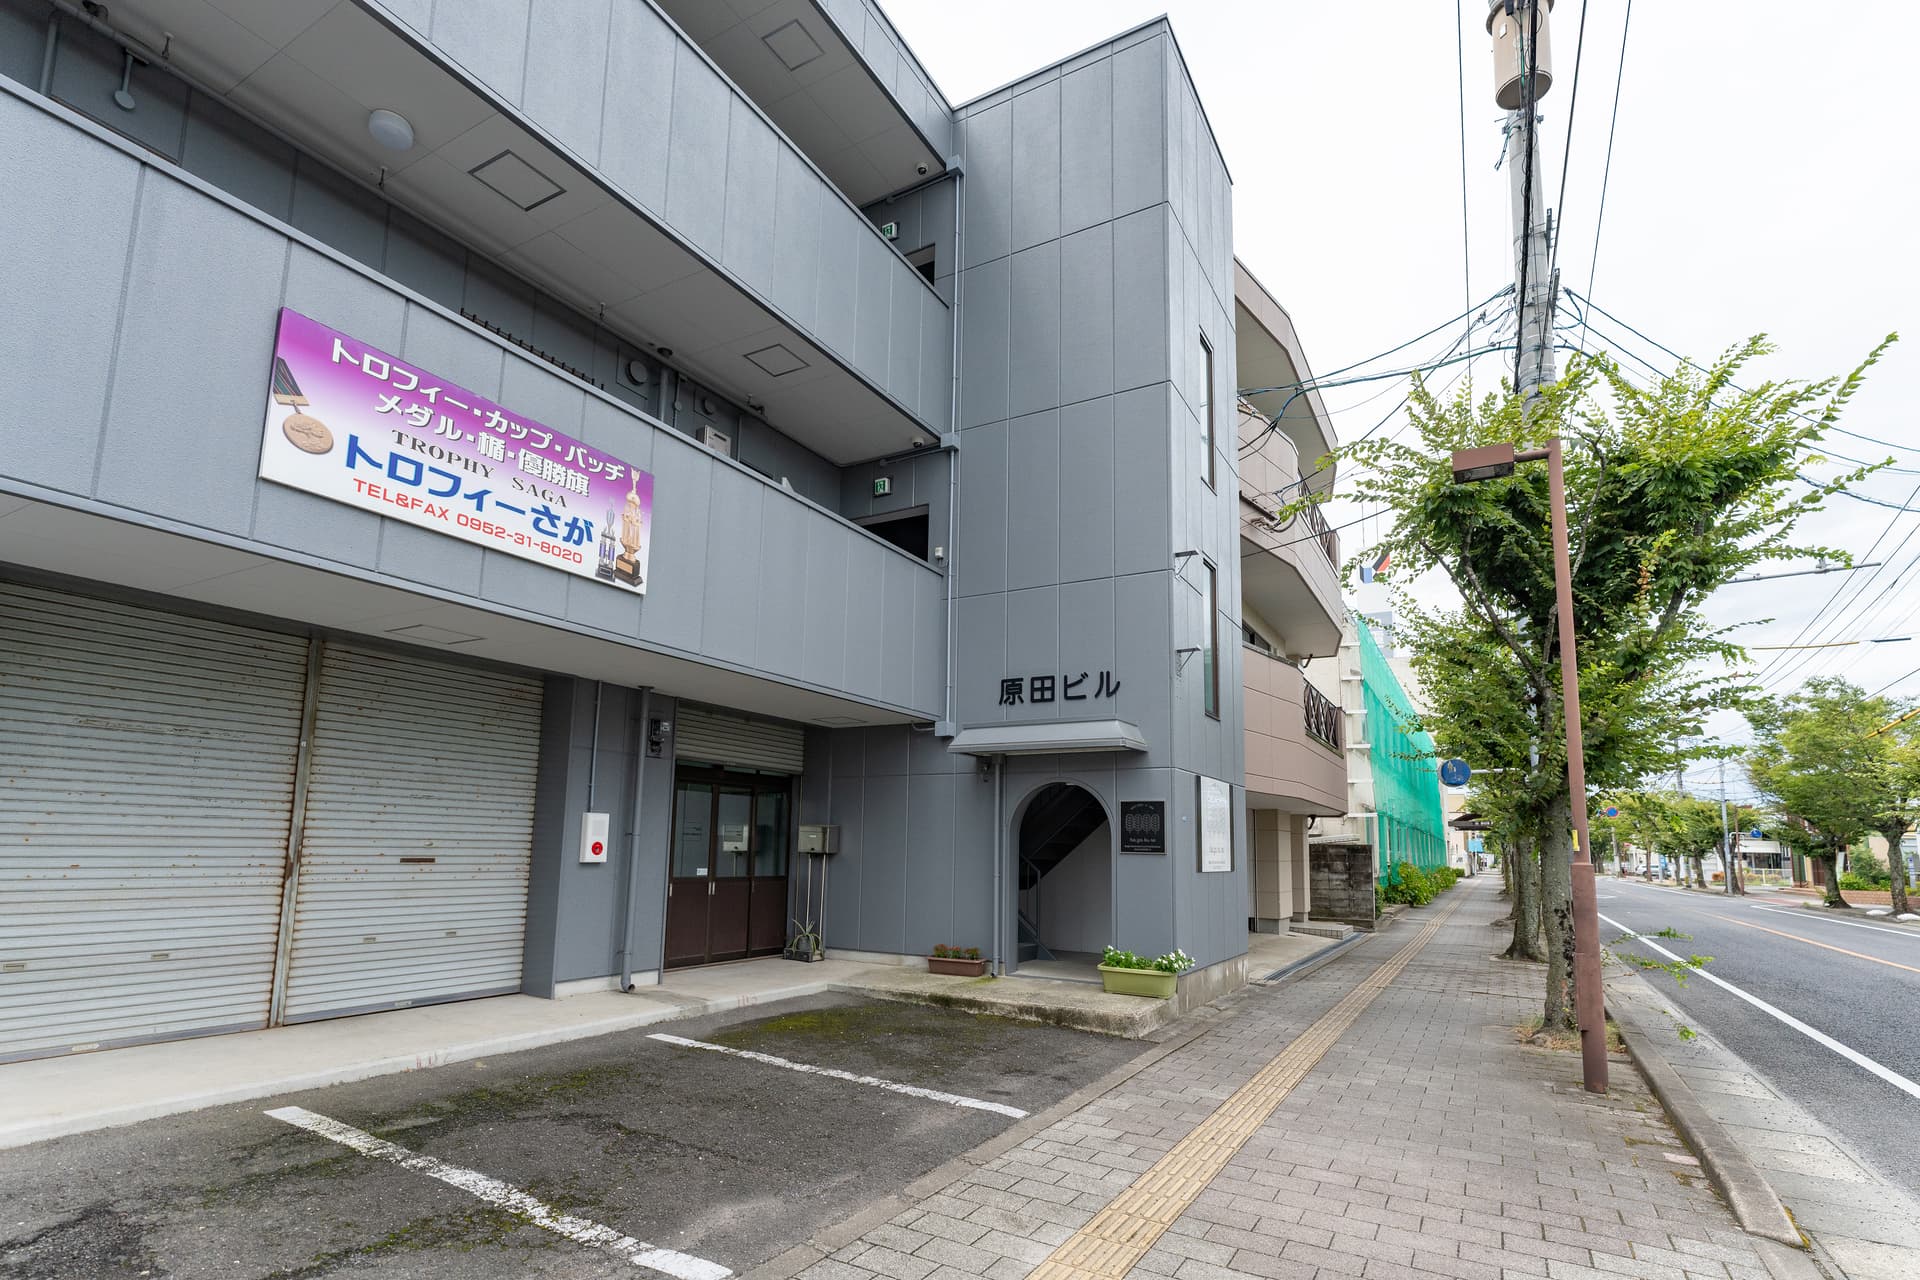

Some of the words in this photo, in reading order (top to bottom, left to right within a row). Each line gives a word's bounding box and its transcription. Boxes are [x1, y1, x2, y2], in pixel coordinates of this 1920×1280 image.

[345, 433, 594, 547] トロフィーさが
[392, 429, 495, 479] TROPHY
[512, 477, 567, 508] SAGA
[353, 478, 450, 521] TEL&FAX
[457, 513, 583, 564] 0952-31-8020
[998, 670, 1121, 706] 原田ビル
